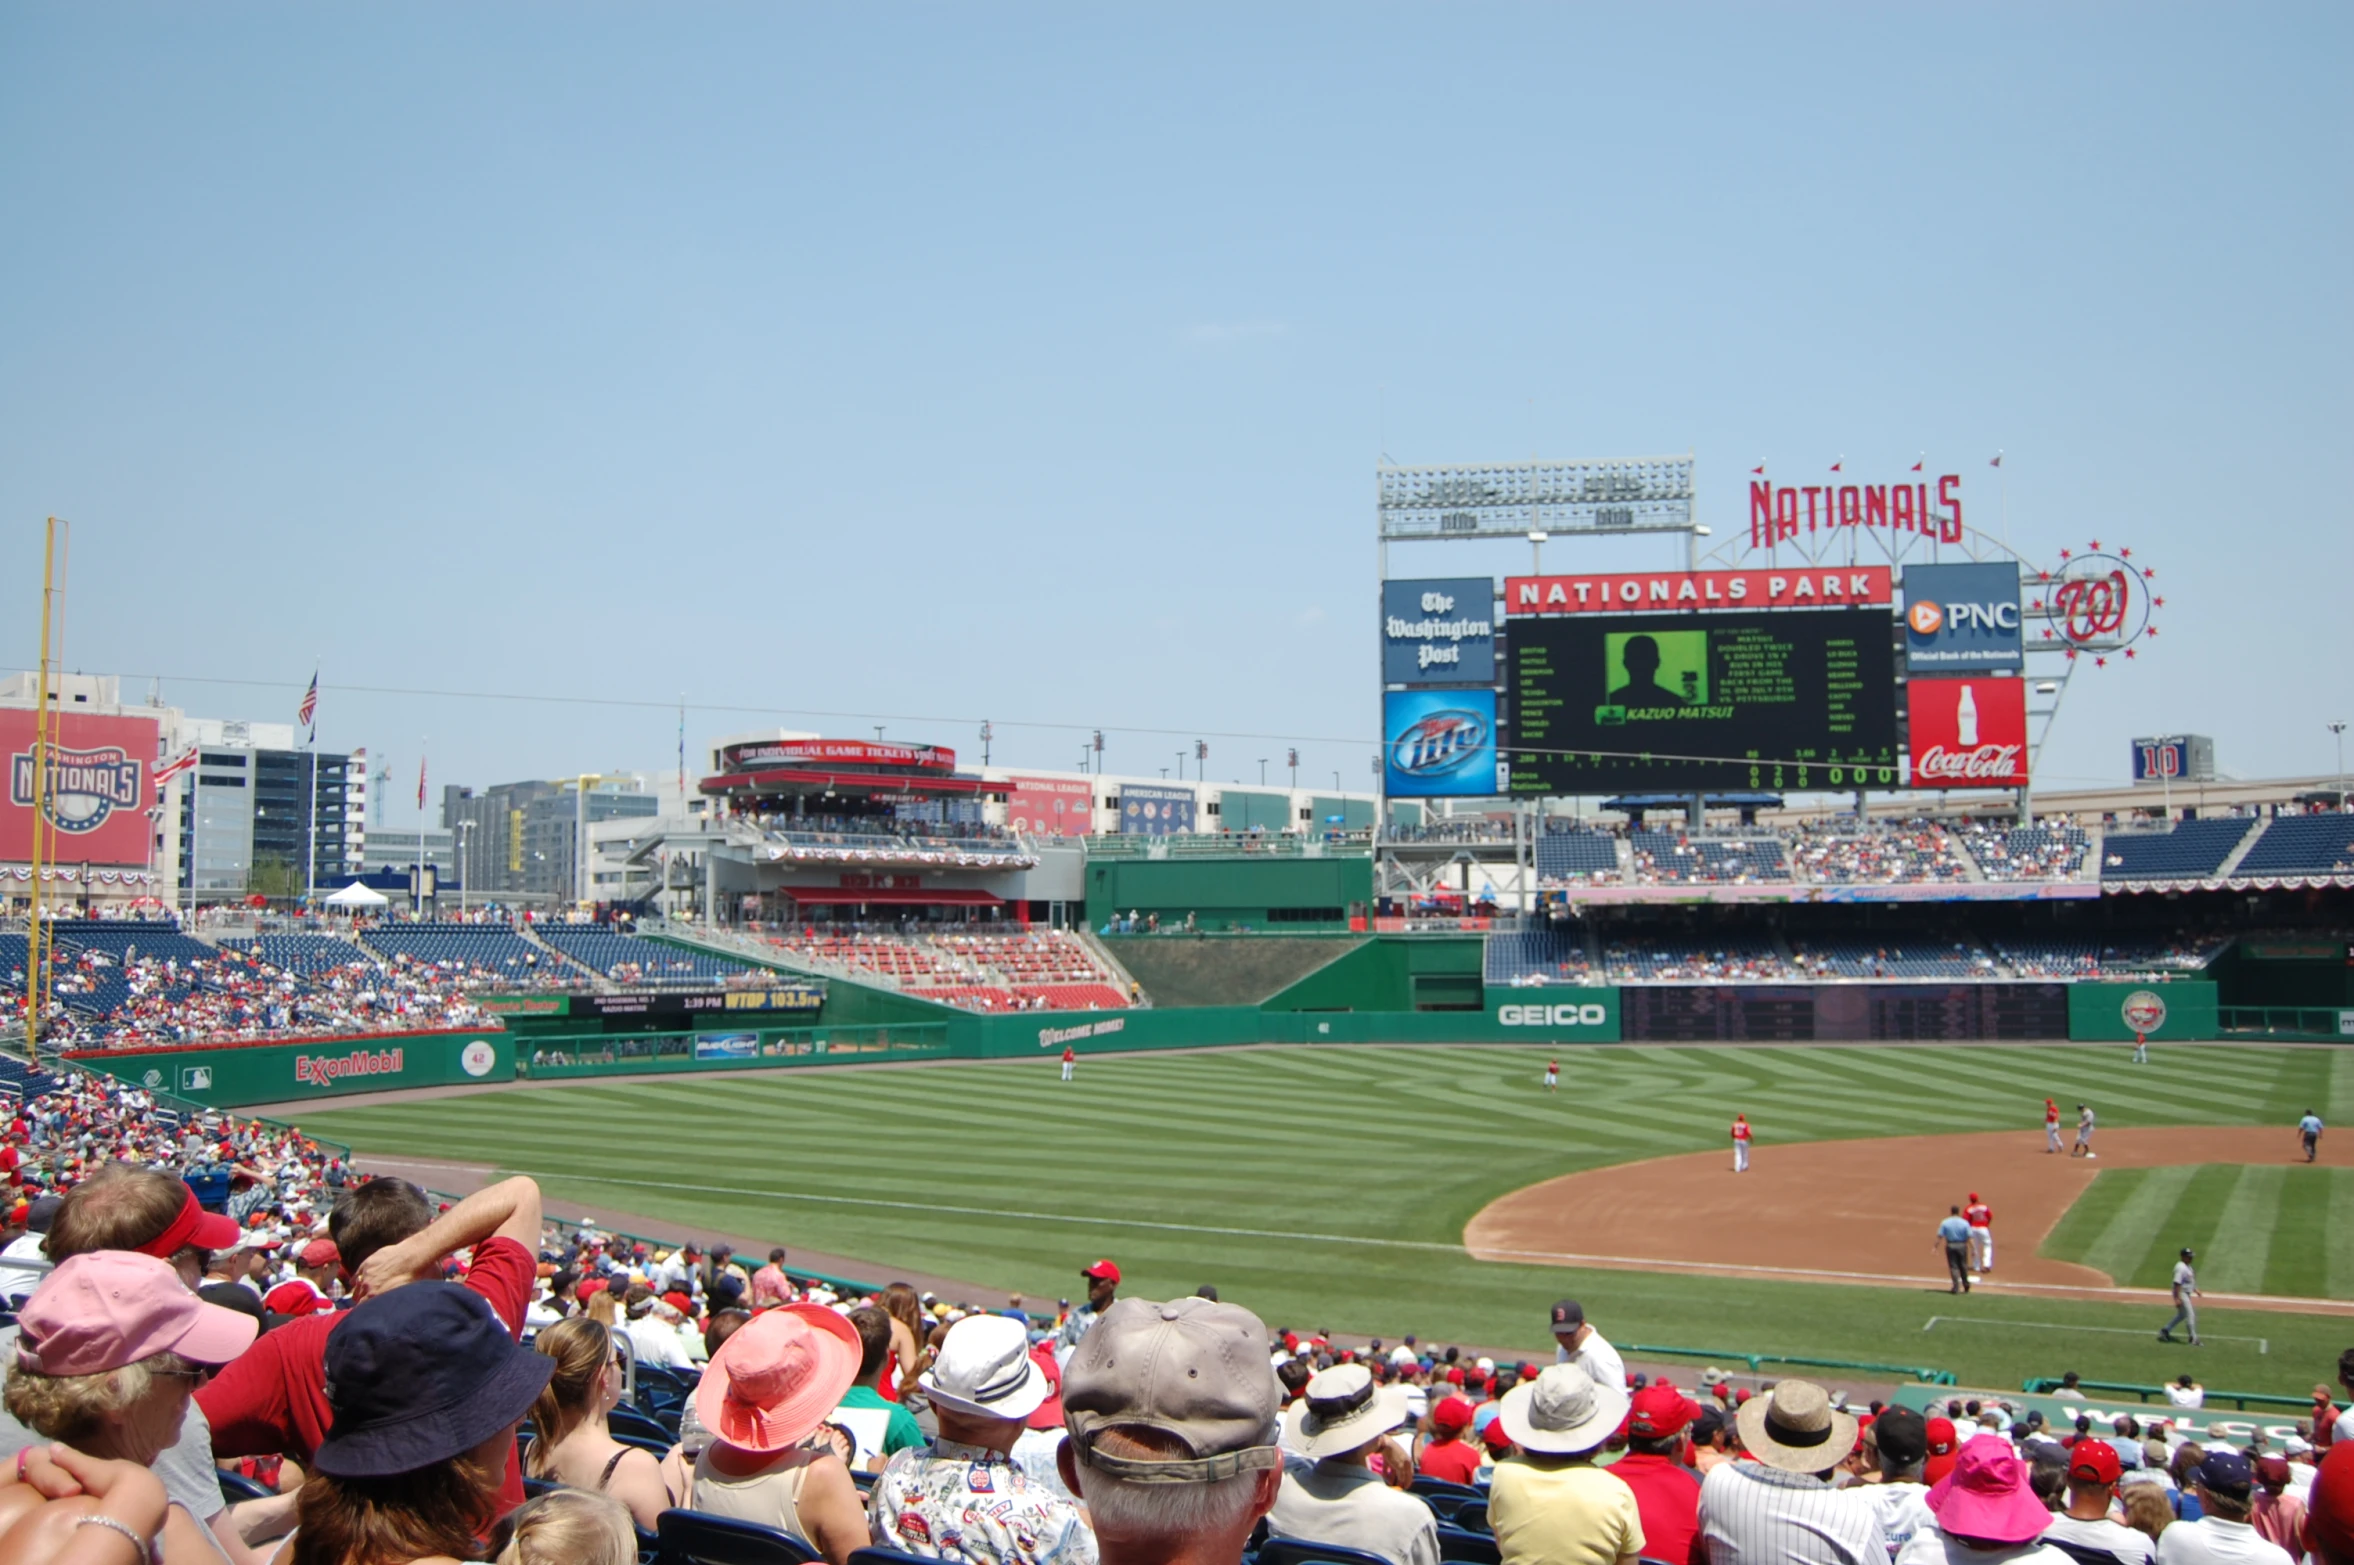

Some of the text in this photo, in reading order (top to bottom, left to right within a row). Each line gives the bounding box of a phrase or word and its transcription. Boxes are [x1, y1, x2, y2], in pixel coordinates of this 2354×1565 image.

[1750, 475, 1962, 548] NATIONALS
[1519, 574, 1872, 604] NATIONALS PARK
[1421, 592, 1455, 614] The
[2055, 569, 2128, 641] W
[1945, 602, 2019, 629] PNC
[1387, 616, 1491, 641] Washington
[1418, 644, 1460, 669] Post
[1910, 650, 2020, 661] Official Bank of the Nationals
[1627, 707, 1676, 720] KAZUO
[1677, 706, 1735, 719] MATSUI
[44, 751, 118, 765] ASHINGTON
[758, 746, 823, 757] INDIVIDUAL
[825, 746, 864, 757] GAME
[867, 748, 912, 759] TICKETS
[1408, 726, 1478, 770] Lite
[1919, 744, 2021, 779] Coca-Cola
[2143, 746, 2179, 778] 10
[1750, 776, 1760, 788] 0
[1773, 776, 1783, 788] 0
[1798, 776, 1808, 788] 0
[1829, 766, 1892, 784] 0 0 0
[1058, 785, 1089, 794] LEAGUE
[1123, 788, 1192, 801] AMERICAN LEAGUE
[706, 998, 723, 1008] PM
[725, 993, 765, 1009] WTOP
[1498, 1004, 1606, 1026] GEICO
[1039, 1024, 1092, 1048] WELCOME
[296, 1048, 404, 1086] ExxonMobil
[471, 1053, 486, 1064] 42
